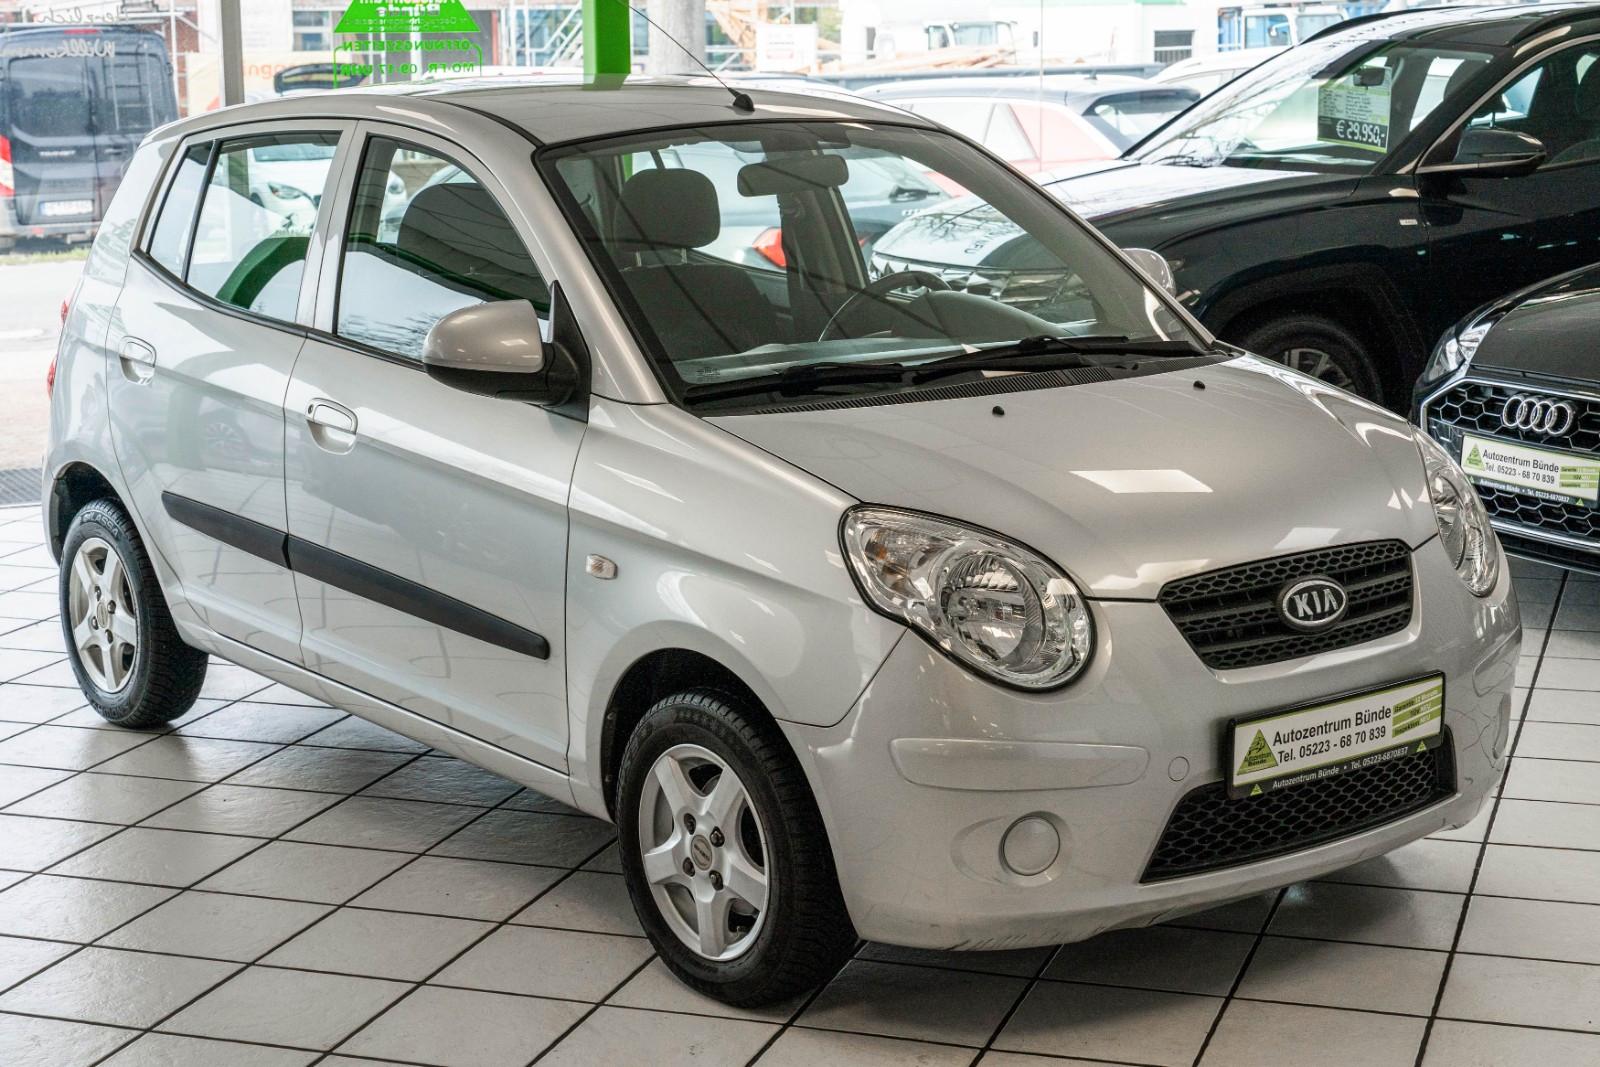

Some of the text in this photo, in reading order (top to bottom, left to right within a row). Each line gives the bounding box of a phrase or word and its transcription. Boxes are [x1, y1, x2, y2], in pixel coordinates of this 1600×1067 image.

[1482, 449, 1531, 467] Autozentrum
[1532, 459, 1559, 473] Bünde
[1485, 462, 1495, 473] Tel.
[1497, 465, 1517, 477] 05223
[1522, 470, 1531, 480] 68
[1532, 472, 1541, 481] 70
[1542, 474, 1555, 484] 839
[1293, 588, 1339, 617] KIA
[1272, 704, 1392, 747] Autozentrum Bünde
[1278, 748, 1296, 763] Tel.
[1299, 739, 1330, 758] 05223
[1340, 734, 1352, 748] 68
[1355, 731, 1367, 745] 70
[1369, 726, 1387, 741] 839
[1272, 772, 1317, 790] Autozentrum
[1318, 765, 1340, 778] Bünde
[1351, 760, 1362, 770] Tel.
